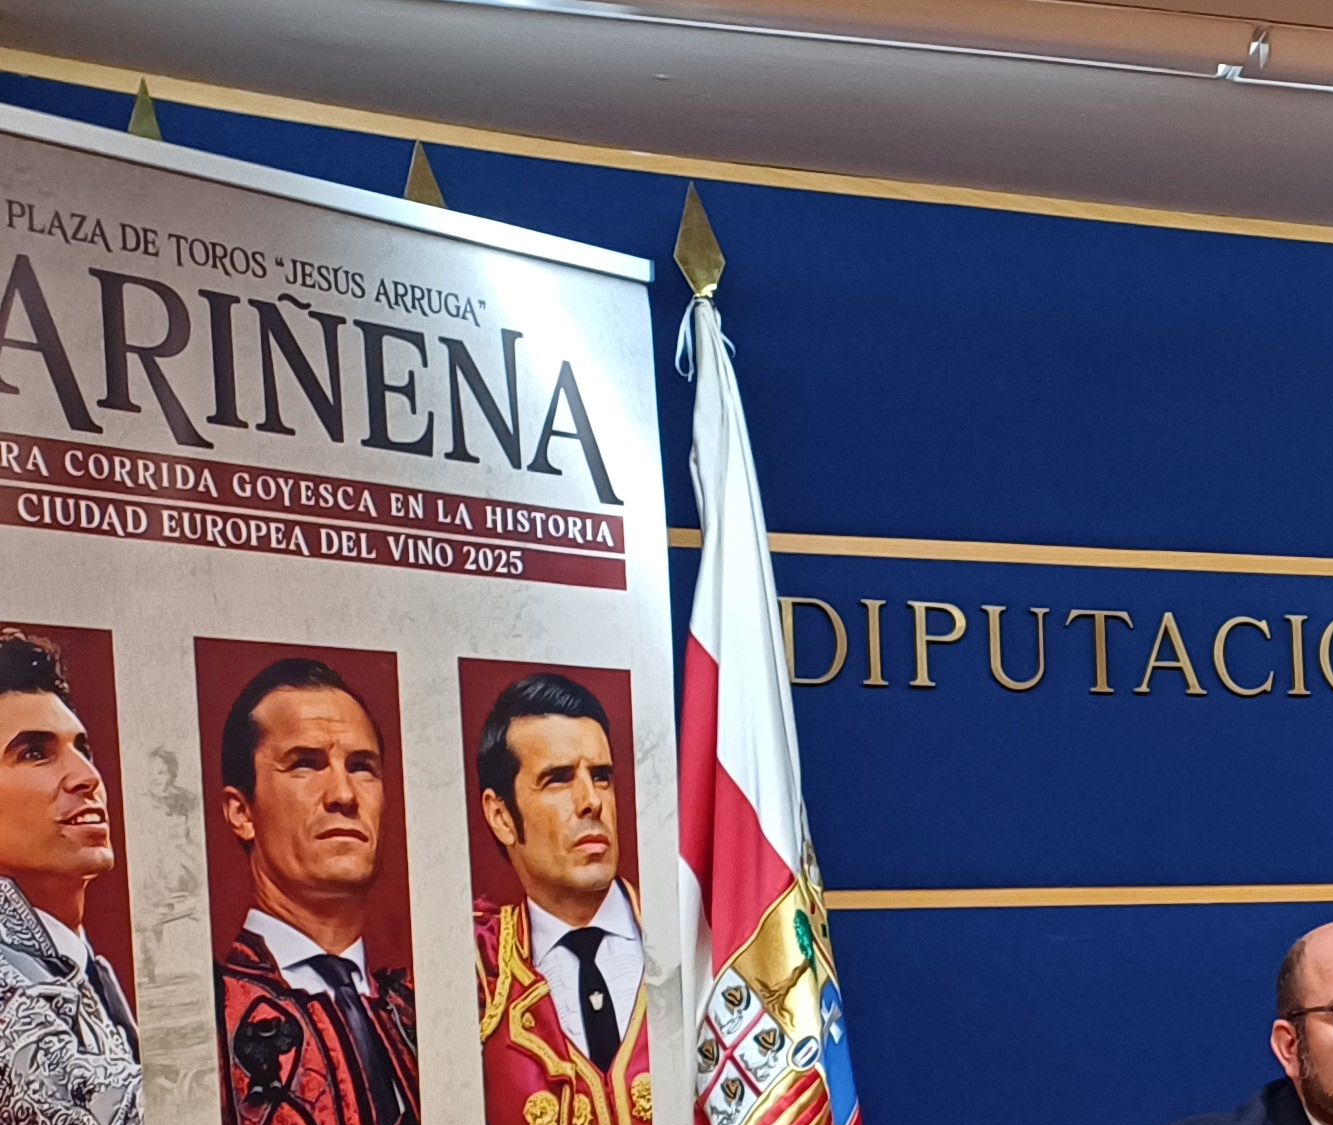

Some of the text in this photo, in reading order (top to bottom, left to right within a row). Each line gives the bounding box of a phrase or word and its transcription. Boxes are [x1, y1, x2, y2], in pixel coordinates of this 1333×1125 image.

[6, 199, 113, 254] PLAZA
[119, 222, 160, 258] DE
[168, 232, 268, 281] TOROS
[17, 492, 525, 576] CIUDAD EUROPEA DEL VINO 2025
[64, 449, 219, 499] CORRIDA
[232, 470, 377, 519] GOYESCA
[389, 490, 424, 521] EN
[437, 497, 472, 532] LA
[485, 503, 615, 548] HISTORIA
